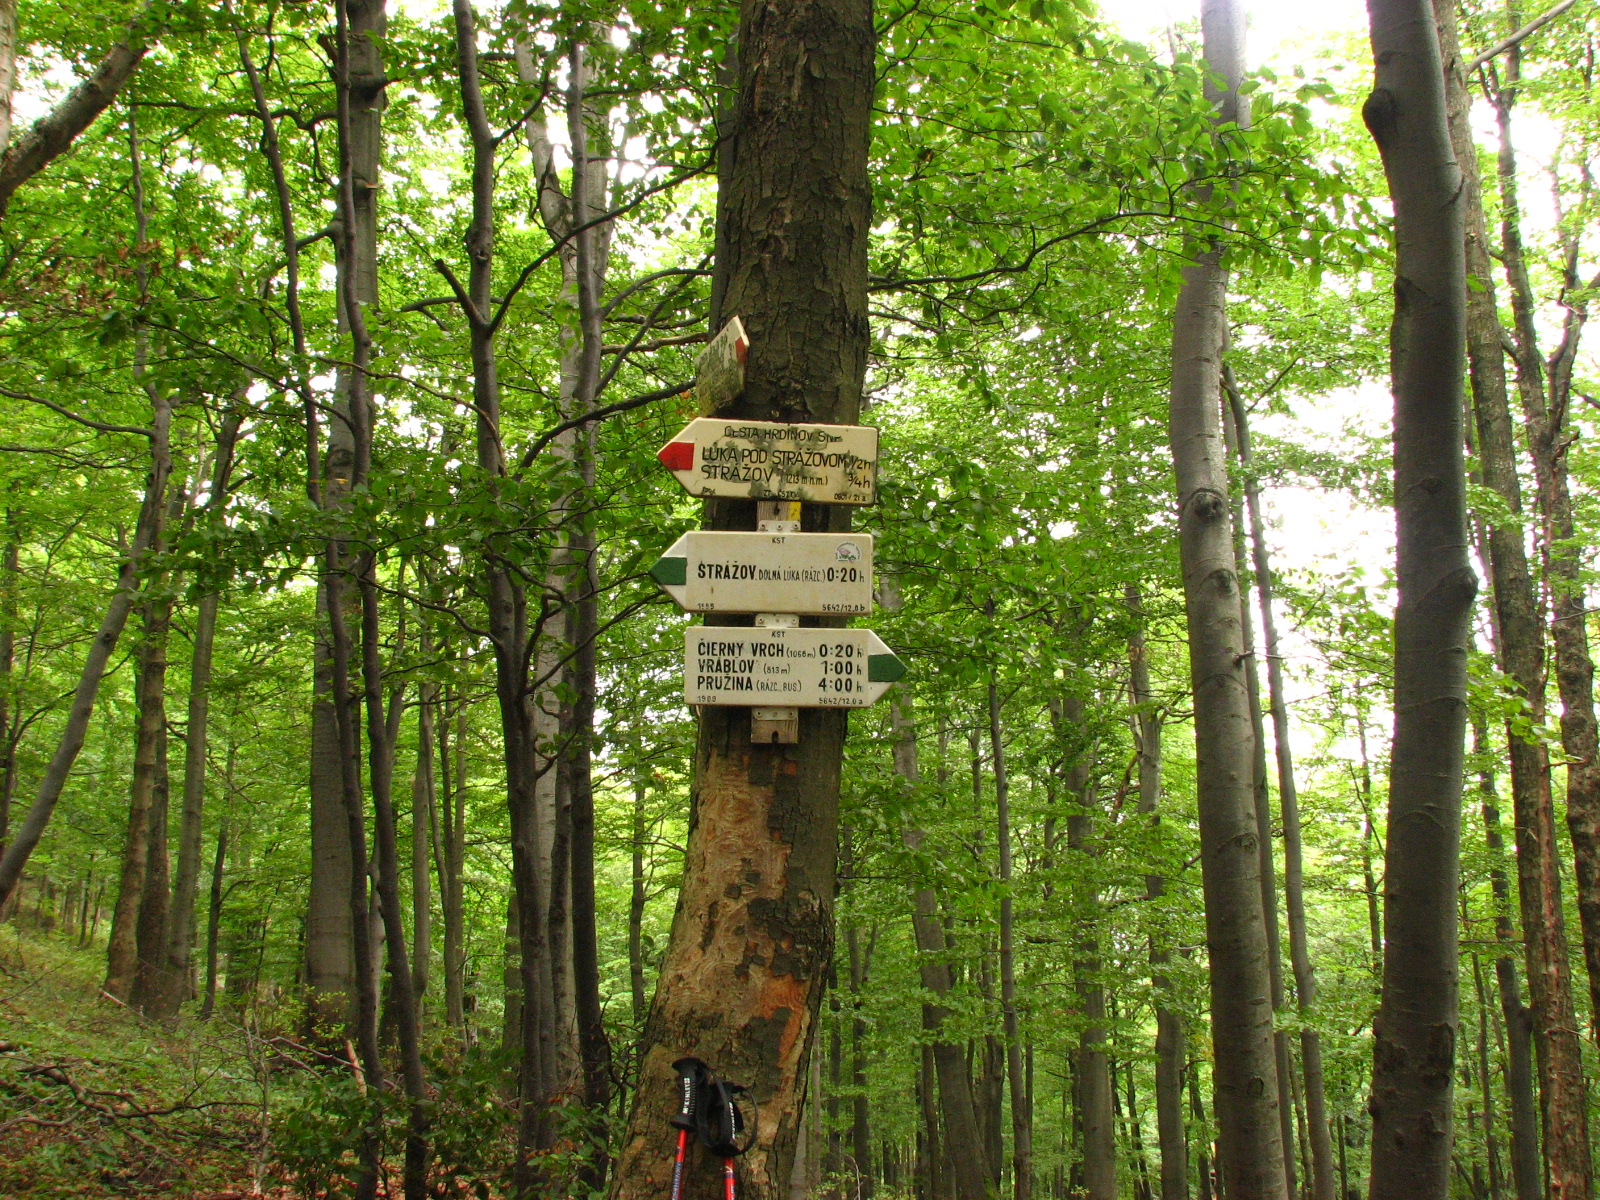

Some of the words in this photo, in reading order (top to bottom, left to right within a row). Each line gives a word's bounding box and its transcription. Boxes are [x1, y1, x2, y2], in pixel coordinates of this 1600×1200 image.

[742, 448, 768, 464] POD
[772, 447, 846, 468] STRÁŽOVOM
[701, 463, 774, 482] STRÁŽOV
[771, 536, 786, 544] KST
[783, 566, 800, 582] LÚKA
[826, 566, 857, 583] 0:20
[771, 630, 786, 638] KST
[751, 642, 785, 658] VRCH
[819, 643, 854, 658] 0:20
[821, 660, 853, 675] 1:00
[856, 664, 862, 676] h
[818, 677, 853, 692] 4:00
[856, 681, 862, 692] h
